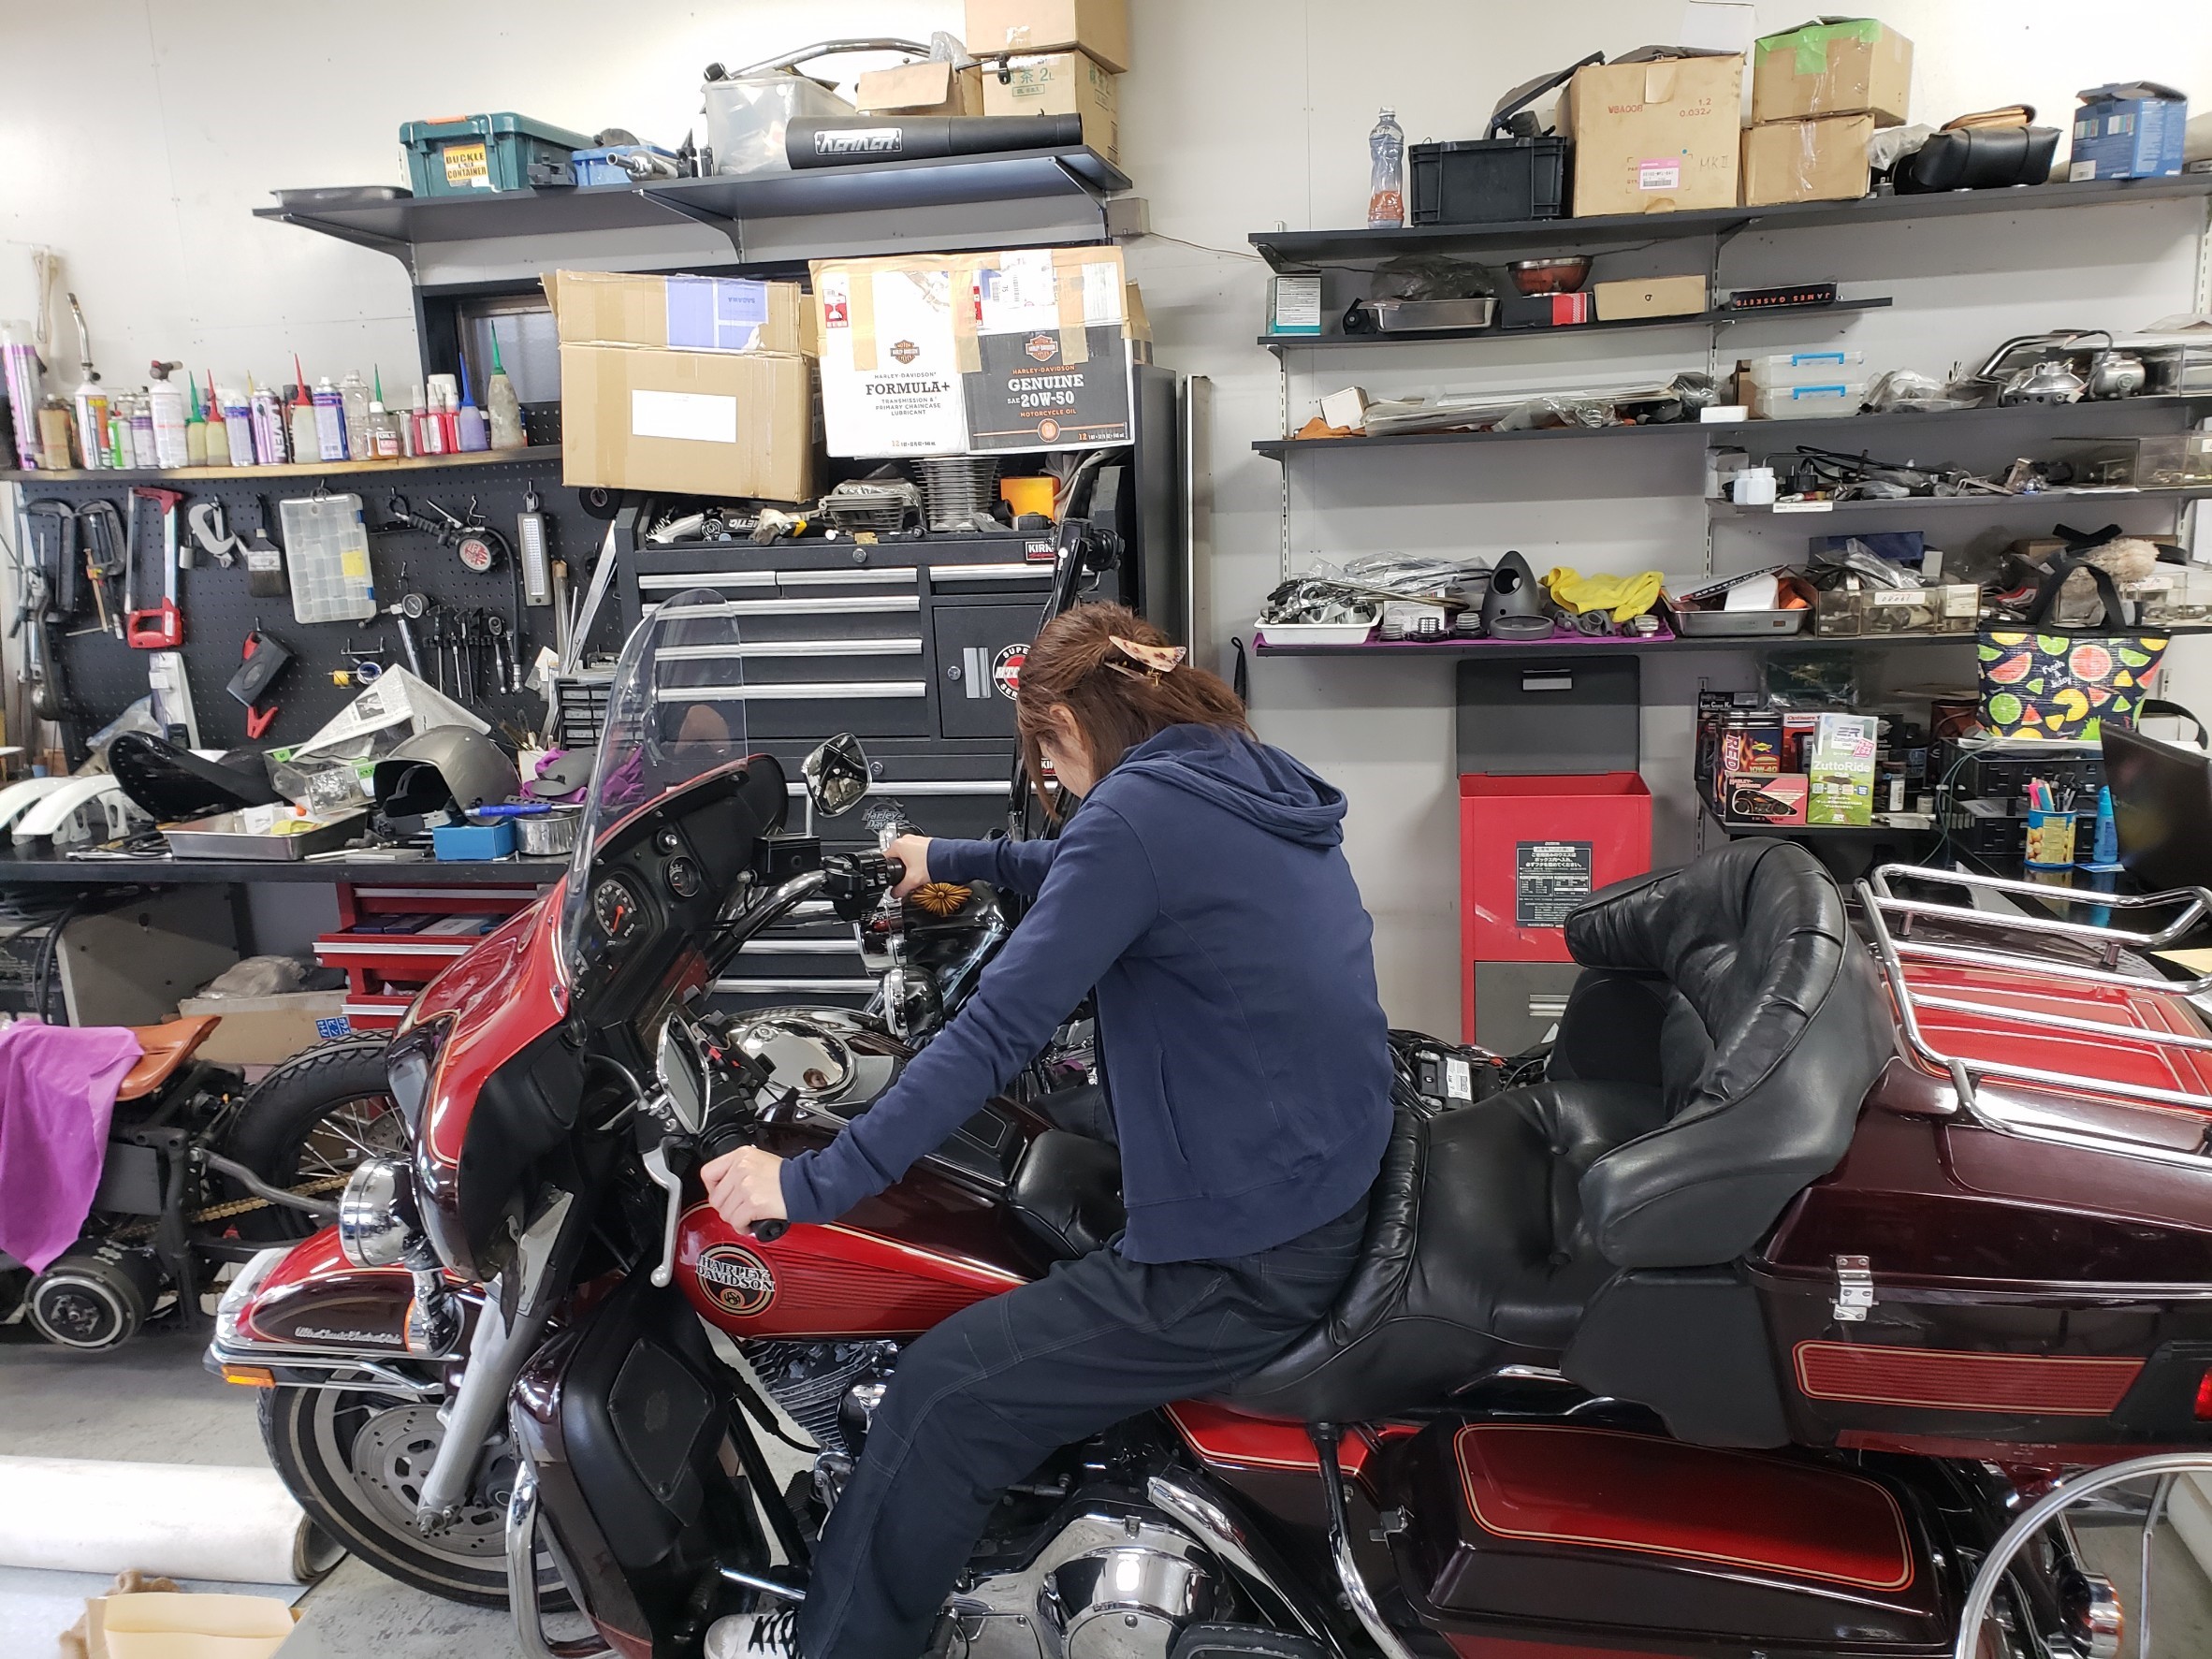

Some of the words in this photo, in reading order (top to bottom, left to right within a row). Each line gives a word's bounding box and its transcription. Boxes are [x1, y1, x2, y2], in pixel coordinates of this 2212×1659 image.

[445, 152, 485, 164] BUCKLE
[1736, 296, 1786, 306] GASKETS
[1793, 292, 1831, 301] JAMES
[1012, 365, 1075, 374] HARLEY-DAVIDSON
[866, 381, 951, 395] FORMULA+
[1008, 373, 1084, 392] GENUINE
[1021, 390, 1075, 408] 20W-50
[1002, 647, 1029, 659] SUPE
[1000, 683, 1018, 699] SER
[1725, 734, 1741, 772] RED
[1813, 760, 1871, 773] ZuttoRide
[694, 1262, 776, 1292] DAVIDSON
